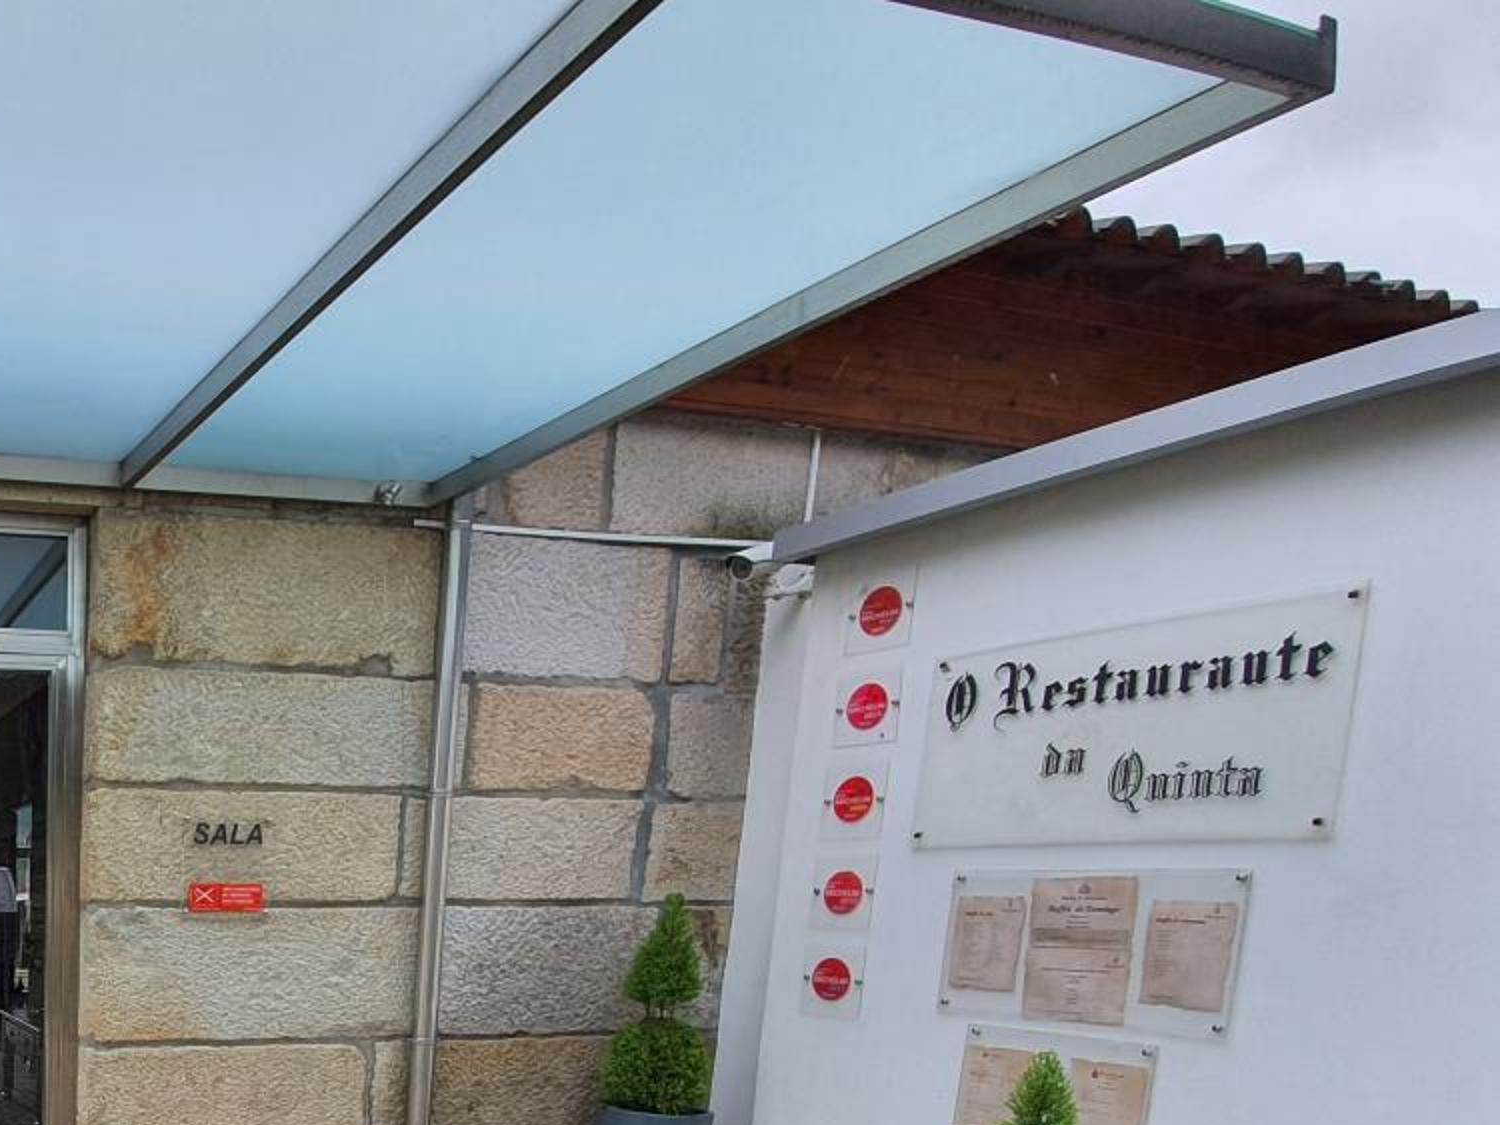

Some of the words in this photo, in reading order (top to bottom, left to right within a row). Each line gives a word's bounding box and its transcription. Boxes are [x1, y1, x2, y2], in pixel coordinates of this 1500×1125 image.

[945, 672, 978, 731] O
[993, 631, 1334, 731] Restaurante
[1040, 742, 1087, 779] da
[1107, 748, 1265, 814] Quinta
[193, 821, 263, 845] SALA
